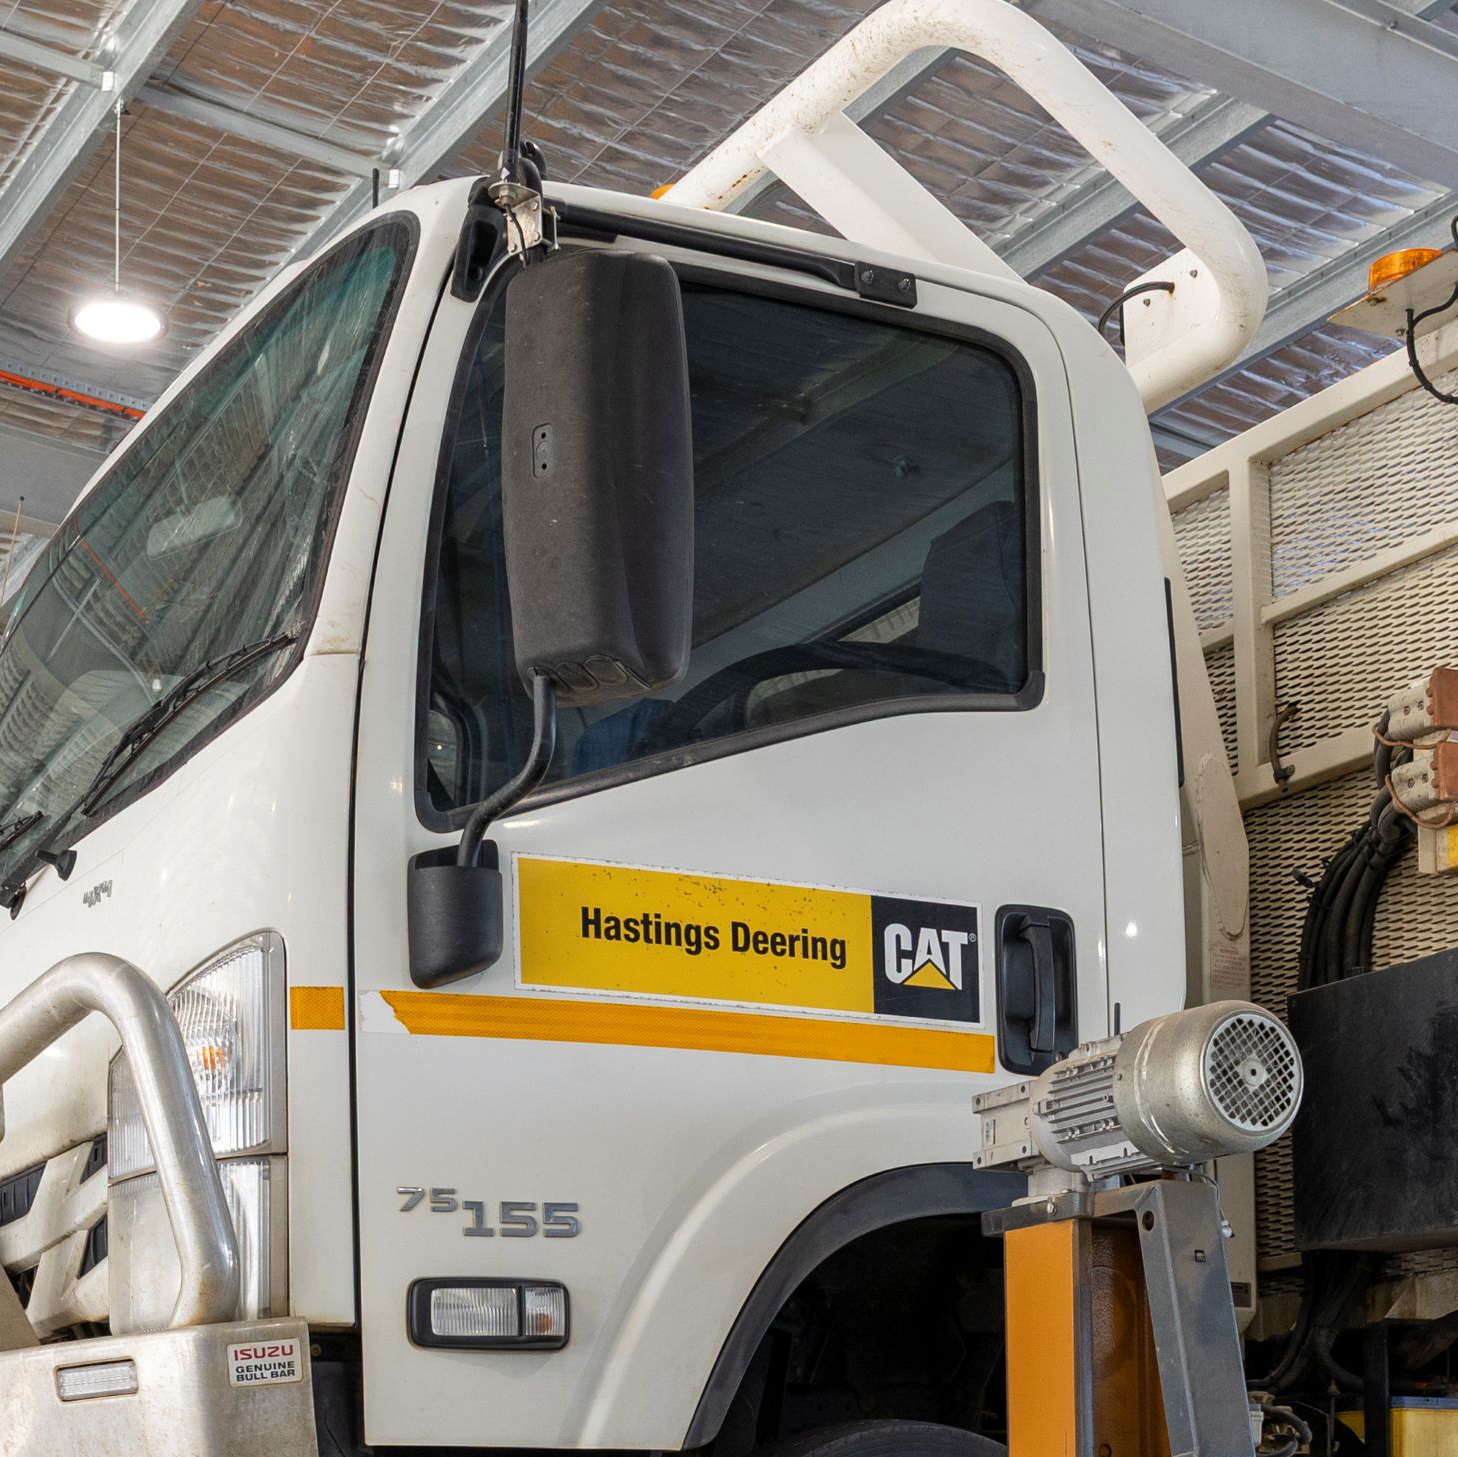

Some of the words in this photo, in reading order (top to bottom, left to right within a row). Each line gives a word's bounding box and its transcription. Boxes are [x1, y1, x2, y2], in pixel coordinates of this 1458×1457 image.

[581, 906, 721, 954] Hastings
[731, 921, 847, 970] Deering
[883, 923, 969, 990] CAT
[396, 1185, 458, 1213] 75
[462, 1200, 579, 1239] 155
[234, 1344, 294, 1361] ISUZU
[235, 1360, 295, 1374] GENUINE
[236, 1372, 267, 1382] BULL
[271, 1369, 295, 1379] BAR
